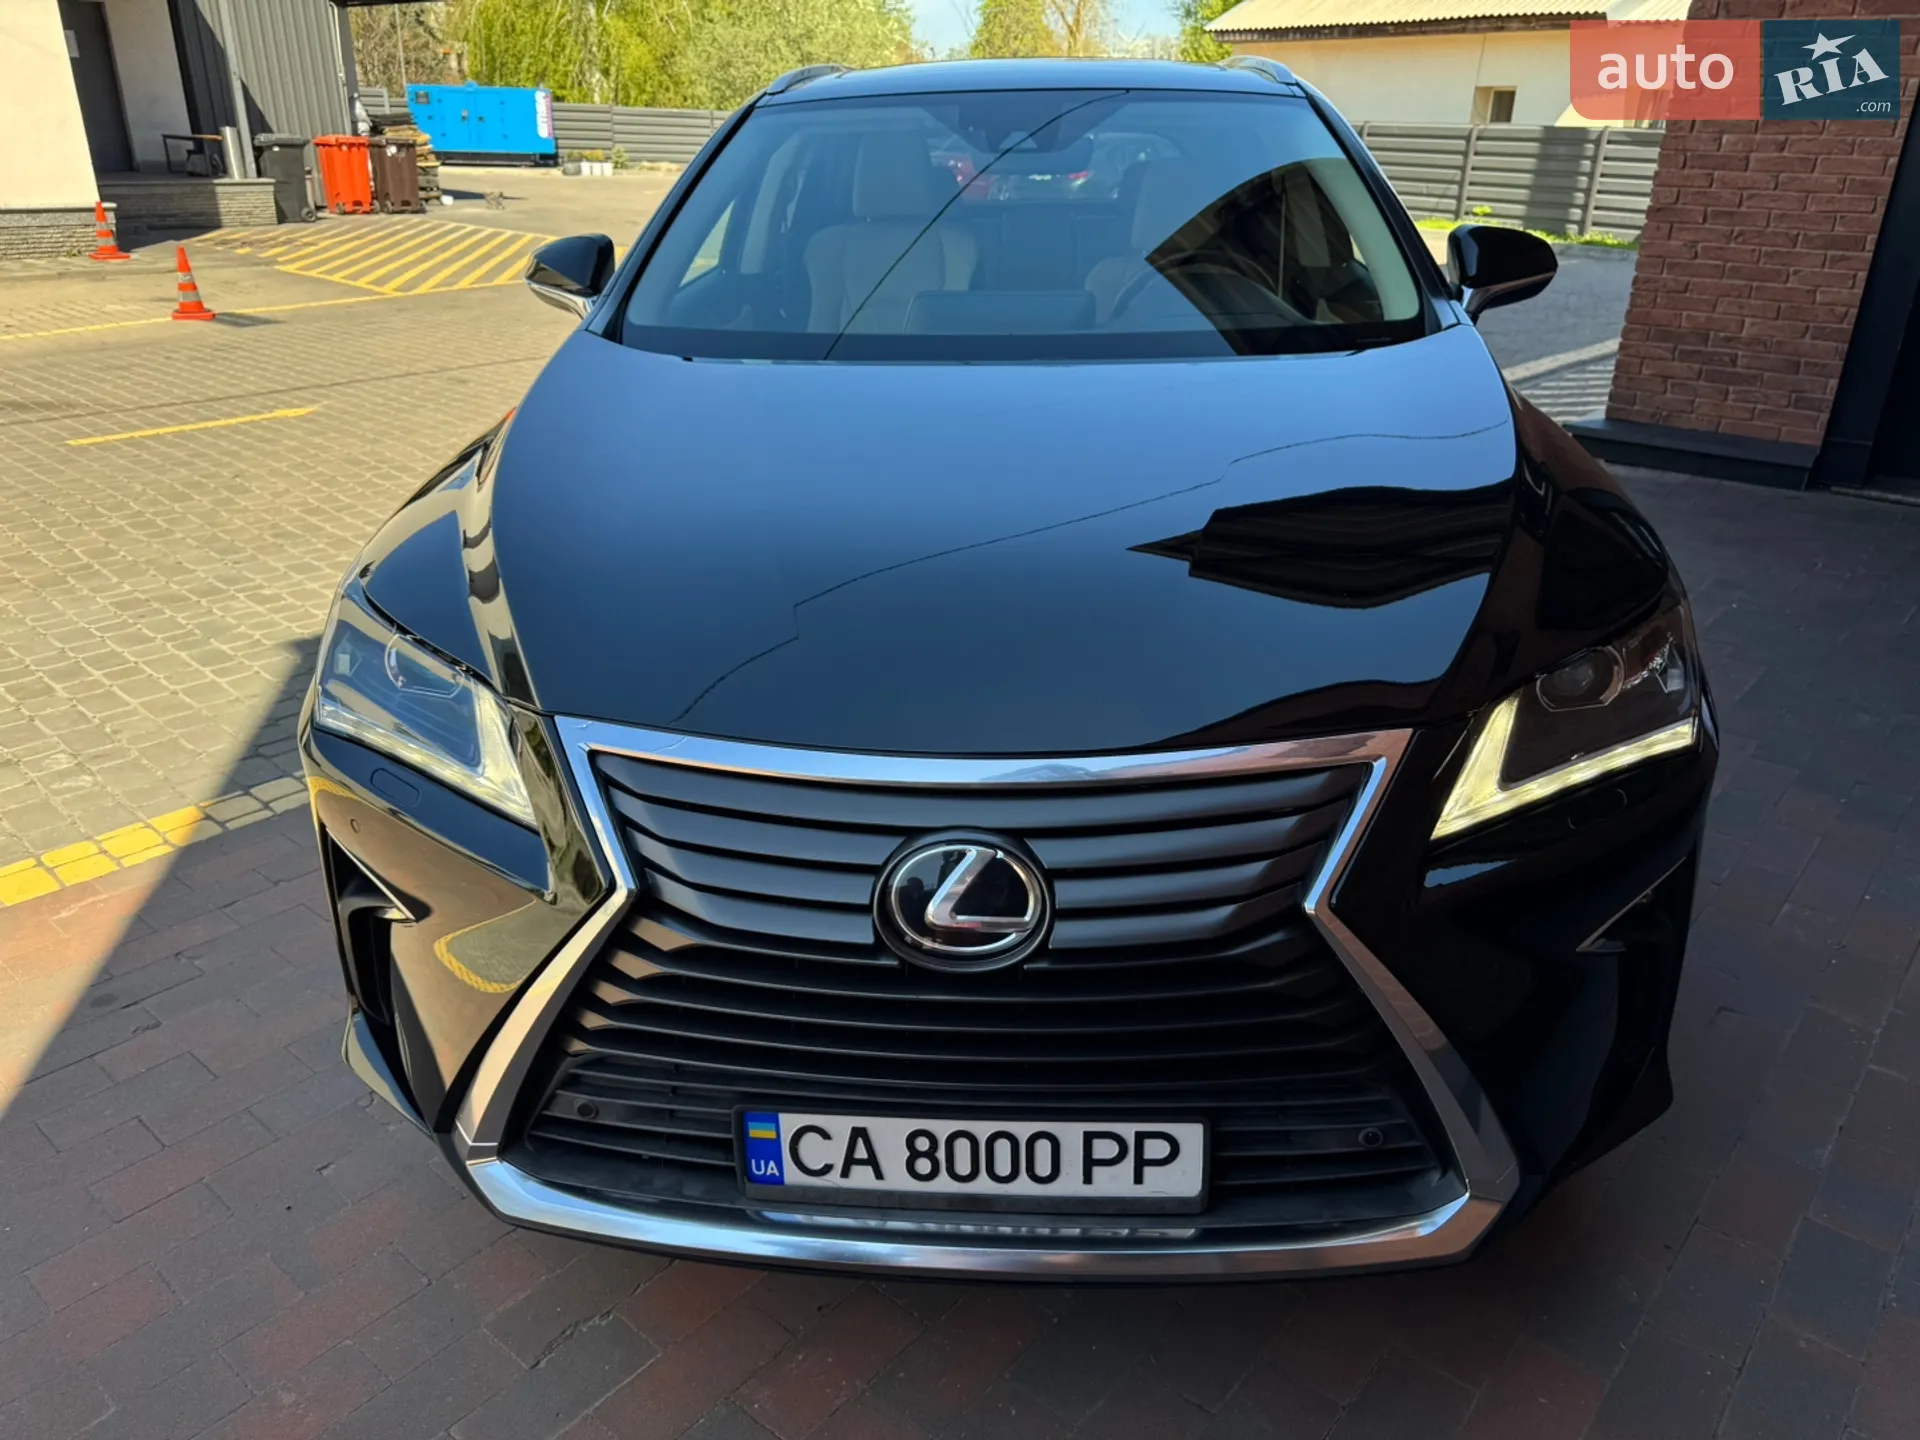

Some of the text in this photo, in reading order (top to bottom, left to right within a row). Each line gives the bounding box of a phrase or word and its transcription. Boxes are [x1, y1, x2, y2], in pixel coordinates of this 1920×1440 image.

[751, 1158, 780, 1177] UA
[787, 1124, 1181, 1185] CA 8000 PP
